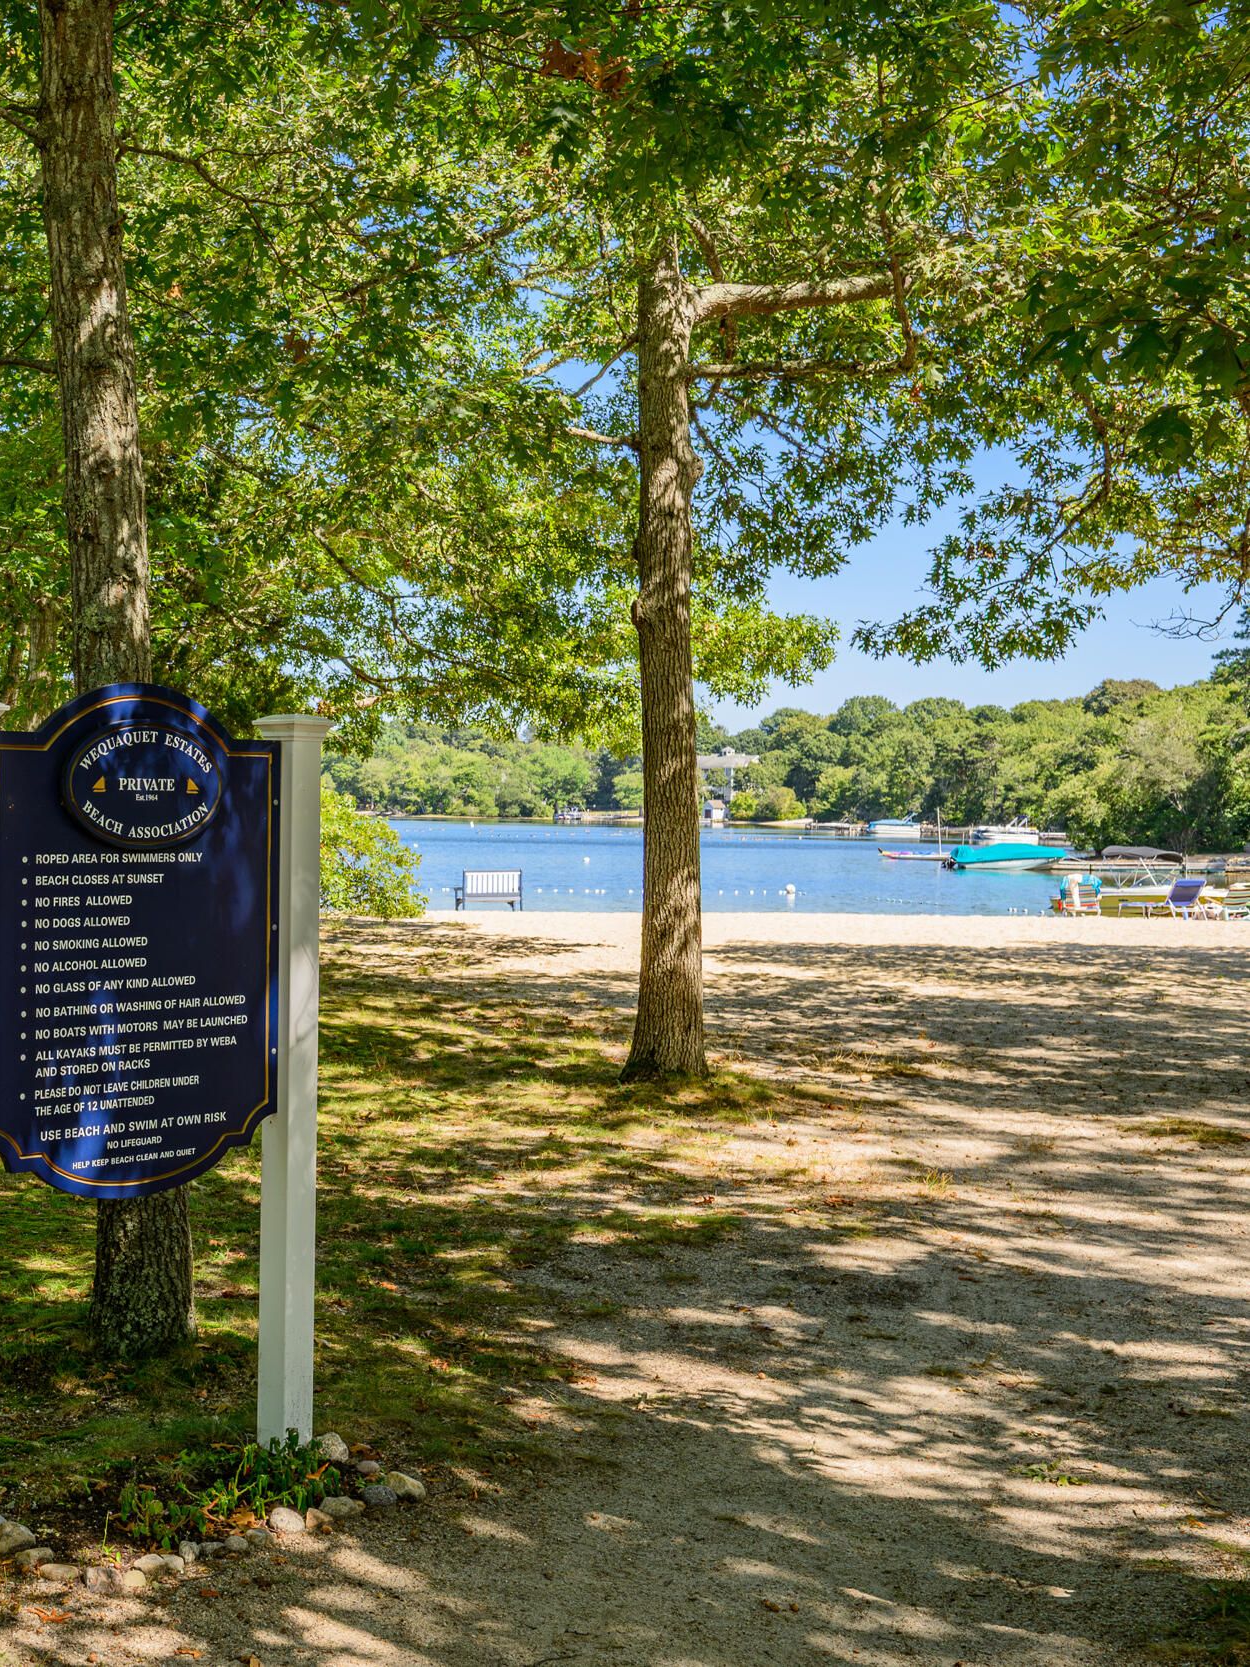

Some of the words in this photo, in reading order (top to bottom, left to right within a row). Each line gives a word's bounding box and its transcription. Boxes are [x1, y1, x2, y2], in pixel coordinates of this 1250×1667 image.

[80, 731, 159, 771] WEQUAQUET
[164, 733, 213, 773] ESTATES
[118, 777, 175, 791] PRIVATE
[82, 800, 123, 835] BEACH
[128, 801, 209, 839] ASSOCIATION
[35, 854, 70, 864] ROPED
[71, 854, 98, 864] AREA
[100, 853, 119, 863] FOR
[121, 853, 175, 863] SWIMMERS
[177, 852, 203, 863] ONLY
[35, 875, 69, 886] BEACH
[71, 874, 109, 885] CLOSES
[111, 874, 125, 884] AT
[127, 873, 164, 884] SUNSET
[35, 897, 50, 907] NO
[53, 896, 80, 907] FIRES
[85, 895, 132, 906] ALLOWED
[35, 918, 50, 929] NO
[52, 917, 81, 928] DOGS
[83, 916, 130, 926] ALLOWED
[34, 941, 50, 951] NO
[52, 938, 100, 950] SMOKING
[102, 936, 148, 948] ALLOWED
[34, 962, 50, 973] NO
[51, 960, 99, 972] ALCOHOL
[100, 957, 147, 969] ALLOWED
[35, 983, 50, 994] NO
[53, 981, 86, 993] GLASS
[87, 980, 101, 991] OF
[103, 979, 124, 990] ANY
[126, 977, 149, 989] KIND
[151, 975, 196, 988] ALLOWED
[35, 1007, 51, 1018] NO
[53, 1004, 97, 1017] BATHING
[99, 1003, 114, 1014] OR
[115, 1000, 162, 1013] WASHING
[164, 999, 177, 1010] OF
[178, 997, 200, 1009] HAIR
[202, 994, 246, 1007] ALLOWED
[35, 1029, 50, 1040] NO
[53, 1026, 87, 1038] BOATS
[89, 1024, 115, 1036] WITH
[117, 1021, 158, 1034] MOTORS
[163, 1019, 185, 1031] MAY
[186, 1018, 198, 1028] BE
[200, 1014, 248, 1027] LAUNCHED
[35, 1051, 54, 1061] ALL
[56, 1046, 96, 1060] KAYAKS
[98, 1044, 126, 1056] MUST
[128, 1043, 141, 1054] BE
[143, 1039, 194, 1053] PERMITTED
[196, 1037, 208, 1048] BY
[210, 1035, 237, 1047] WEBA
[35, 1066, 57, 1078] AND
[59, 1063, 99, 1076] STORED
[101, 1061, 116, 1073] ON
[118, 1058, 151, 1071] RACKS
[34, 1087, 67, 1100] PLEASE
[68, 1085, 81, 1097] DO
[83, 1084, 101, 1096] NOT
[103, 1081, 128, 1094] LEAVE
[130, 1077, 170, 1091] CHILDREN
[172, 1075, 199, 1087] UNDER
[35, 1106, 52, 1117] THE
[53, 1104, 71, 1116] AGE
[73, 1102, 85, 1113] OF
[87, 1101, 98, 1112] 12
[100, 1095, 155, 1111] UNATTENDED
[40, 1130, 62, 1142] USE
[64, 1125, 100, 1139] BEACH
[103, 1122, 126, 1135] AND
[128, 1119, 158, 1132] SWIM
[160, 1117, 174, 1129] AT
[176, 1114, 201, 1127] OWN
[204, 1111, 227, 1124] RISK
[107, 1140, 119, 1150] NO
[120, 1136, 162, 1148] LIFEGUARD
[72, 1160, 90, 1170] HELP
[91, 1157, 109, 1168] KEEP
[110, 1154, 134, 1165] BEACH
[135, 1152, 158, 1163] CLEAN
[159, 1150, 174, 1159] AND
[176, 1148, 196, 1158] QUIET
